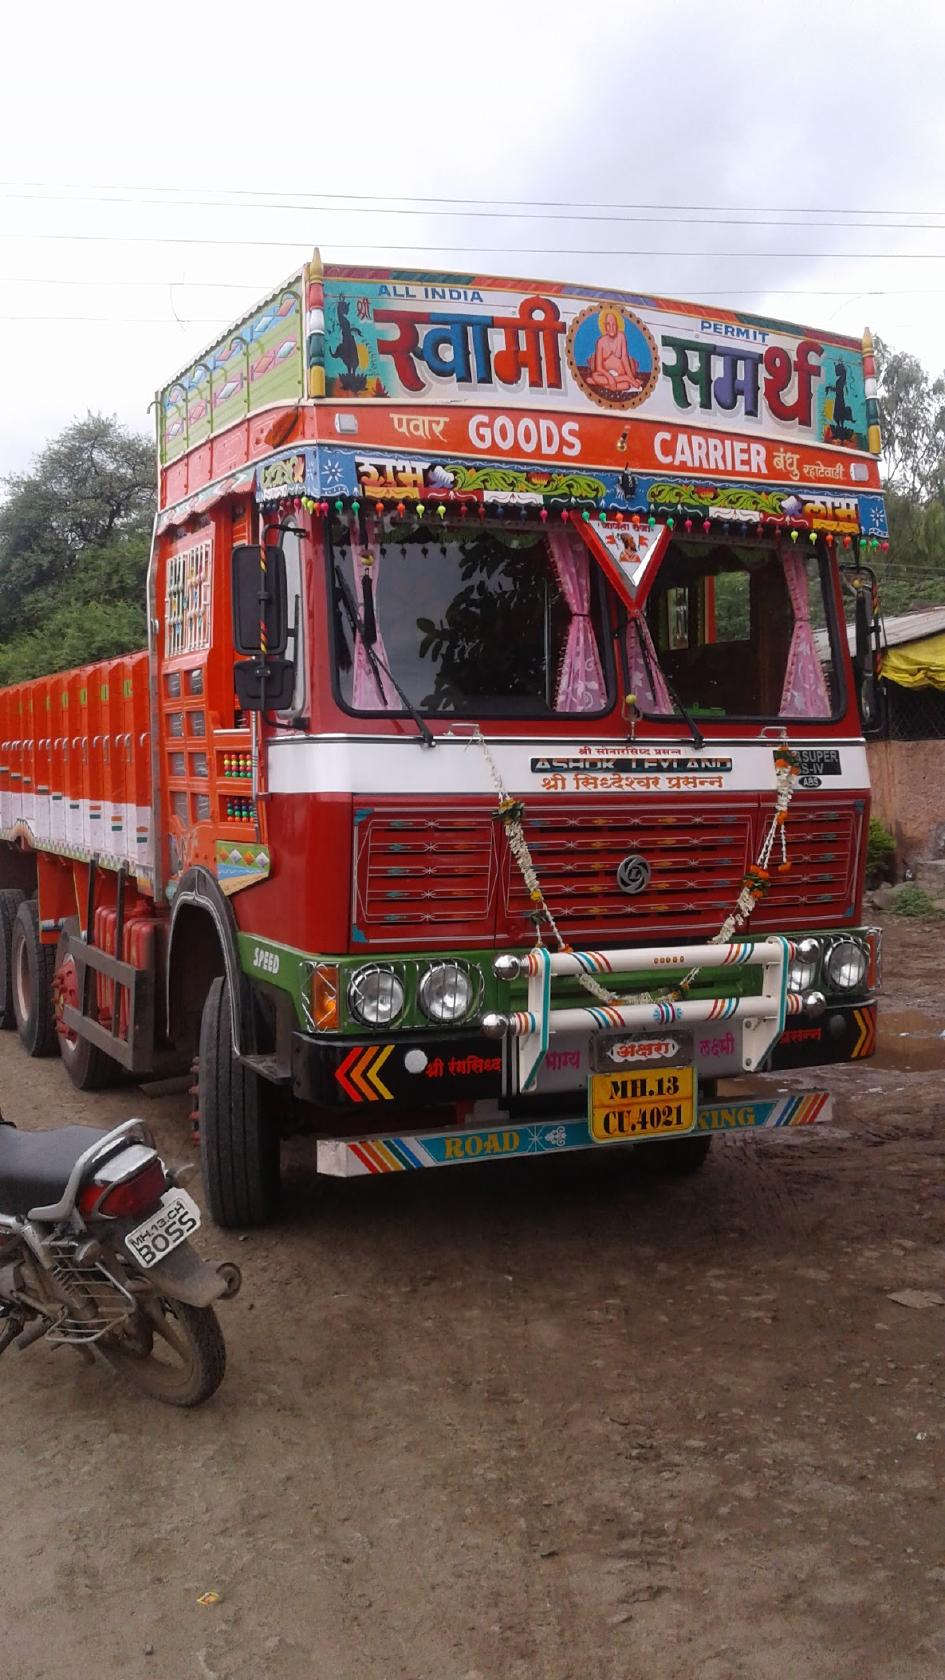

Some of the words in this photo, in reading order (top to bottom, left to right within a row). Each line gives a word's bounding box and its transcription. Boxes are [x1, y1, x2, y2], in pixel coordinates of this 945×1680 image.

[378, 284, 417, 299] ALL
[424, 287, 484, 303] INDIA
[700, 320, 770, 344] PERMIT
[373, 295, 567, 392] स्वामी
[660, 334, 825, 428] समर्थ
[389, 412, 450, 442] पवार
[772, 448, 801, 481] बंधु
[468, 414, 582, 456] GOODS
[654, 431, 769, 474] CARRIER
[799, 763, 824, 775] S-IV
[801, 750, 838, 763] SUPER
[541, 773, 567, 791] श्री
[666, 774, 724, 791] प्रसन्न
[803, 777, 819, 787] ABS
[253, 947, 280, 974] SPEED
[608, 1076, 680, 1100] MH.13
[603, 1105, 684, 1136] CU.4021
[444, 1131, 520, 1159] ROAD
